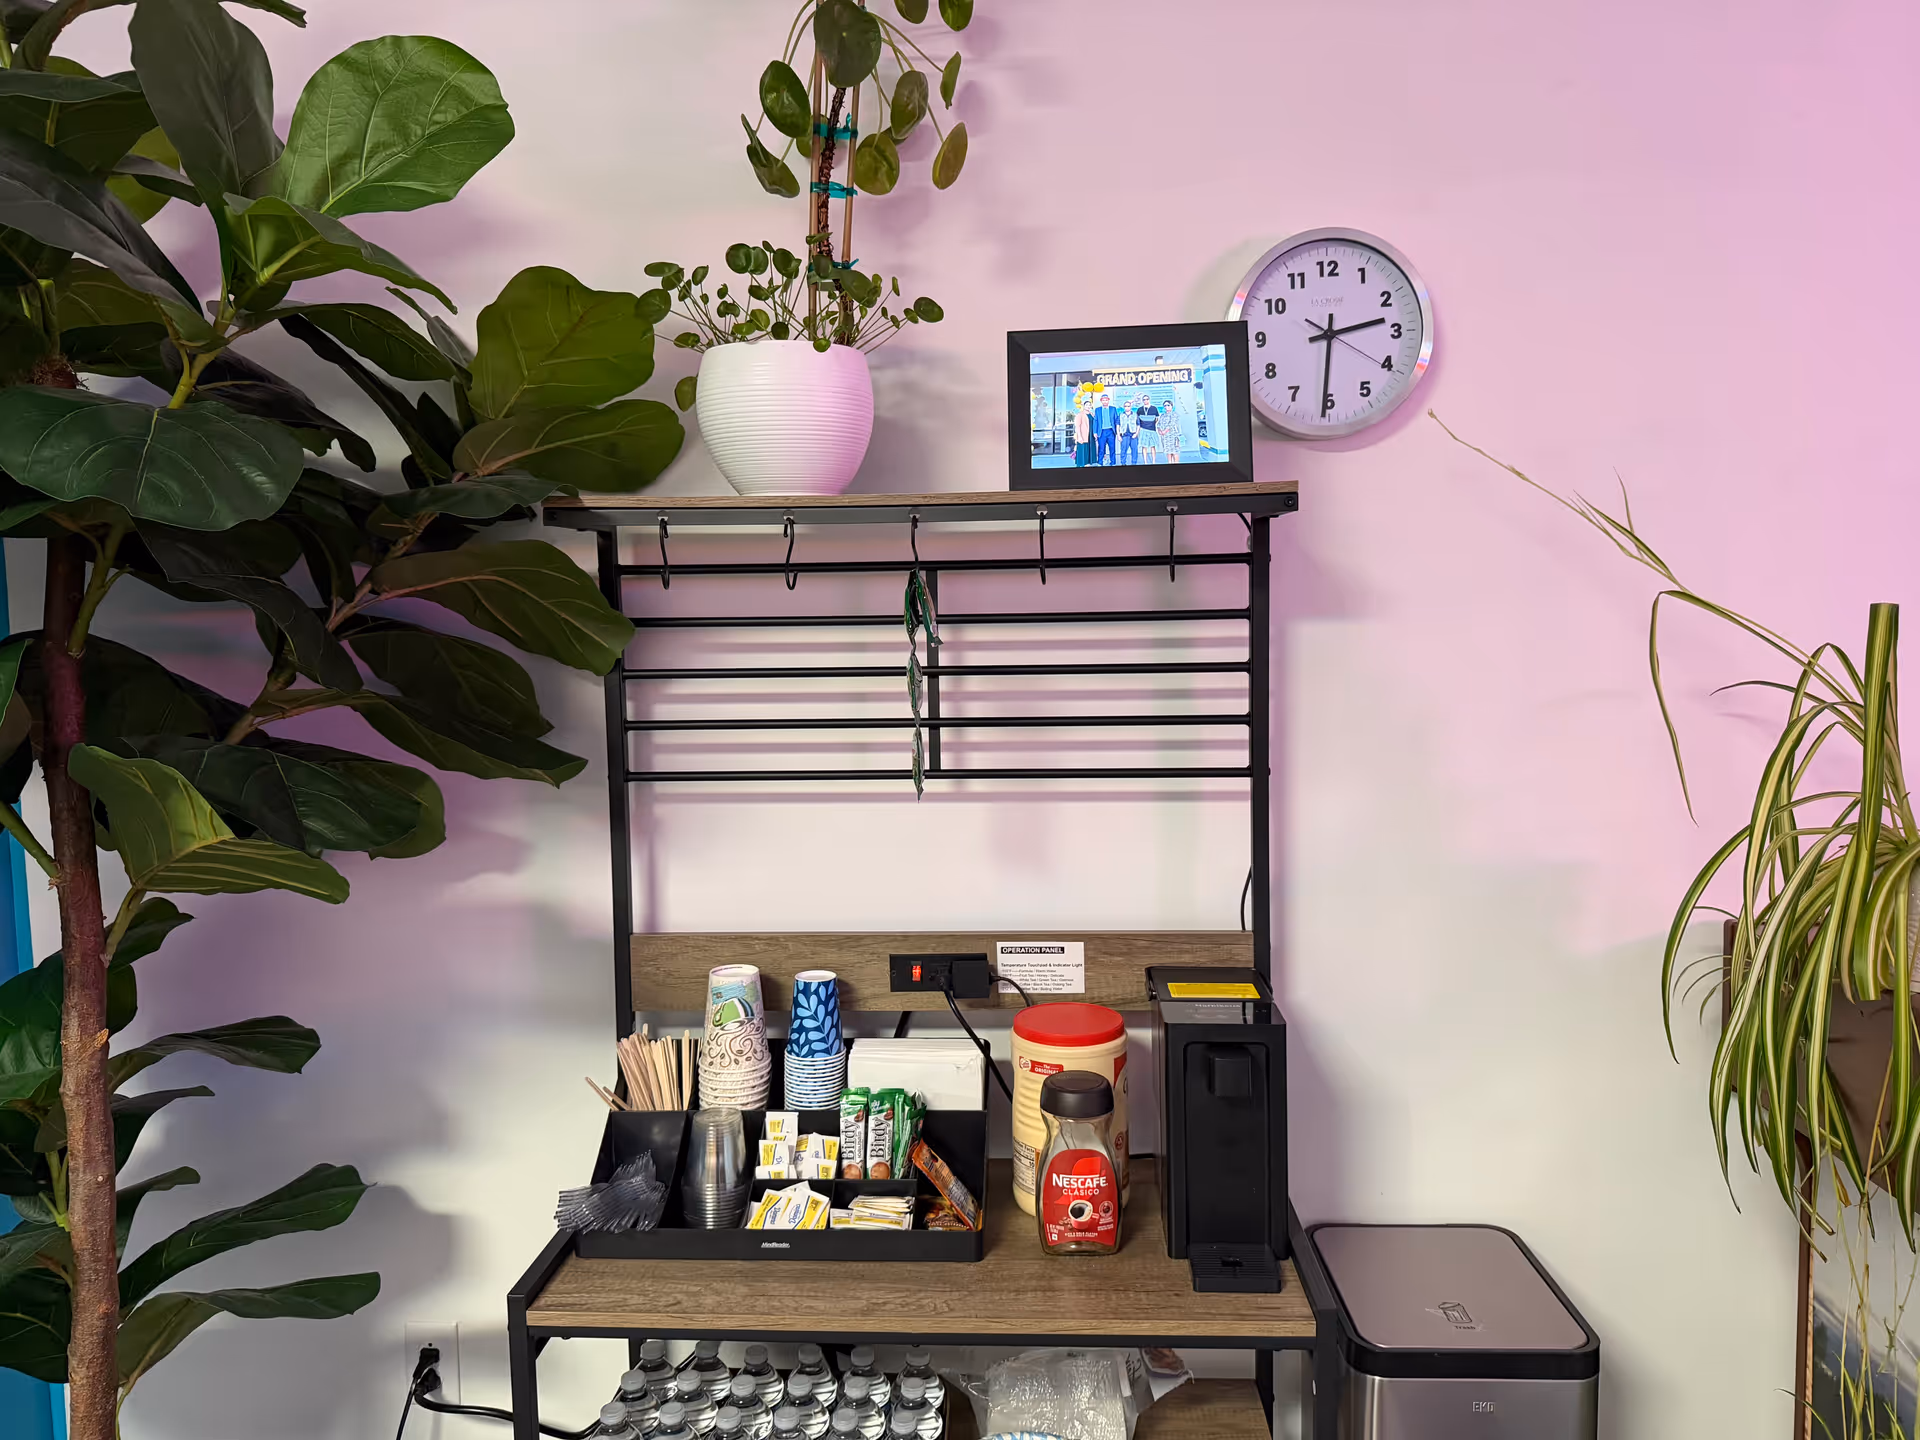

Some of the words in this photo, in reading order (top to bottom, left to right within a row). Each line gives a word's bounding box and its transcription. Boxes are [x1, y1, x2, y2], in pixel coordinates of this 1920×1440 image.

[1316, 260, 1339, 278] 12
[1358, 268, 1366, 284] 1
[1287, 272, 1306, 290] 11
[1264, 298, 1286, 316] 10
[1380, 290, 1392, 308] 2
[1255, 331, 1267, 348] 9
[1390, 322, 1402, 340] 3
[1264, 362, 1277, 380] 8
[1381, 355, 1393, 372] 4
[1097, 372, 1135, 385] GRAND
[1138, 370, 1188, 384] OPENING
[1288, 386, 1300, 402] 7
[1359, 381, 1371, 398] 5
[1324, 393, 1335, 410] 6
[842, 1118, 860, 1160] Birdy
[870, 1117, 890, 1158] Birdy
[1052, 1170, 1107, 1188] NESCAFÉ
[1063, 1187, 1099, 1196] CLÁSICO
[1473, 1401, 1495, 1412] EKO
